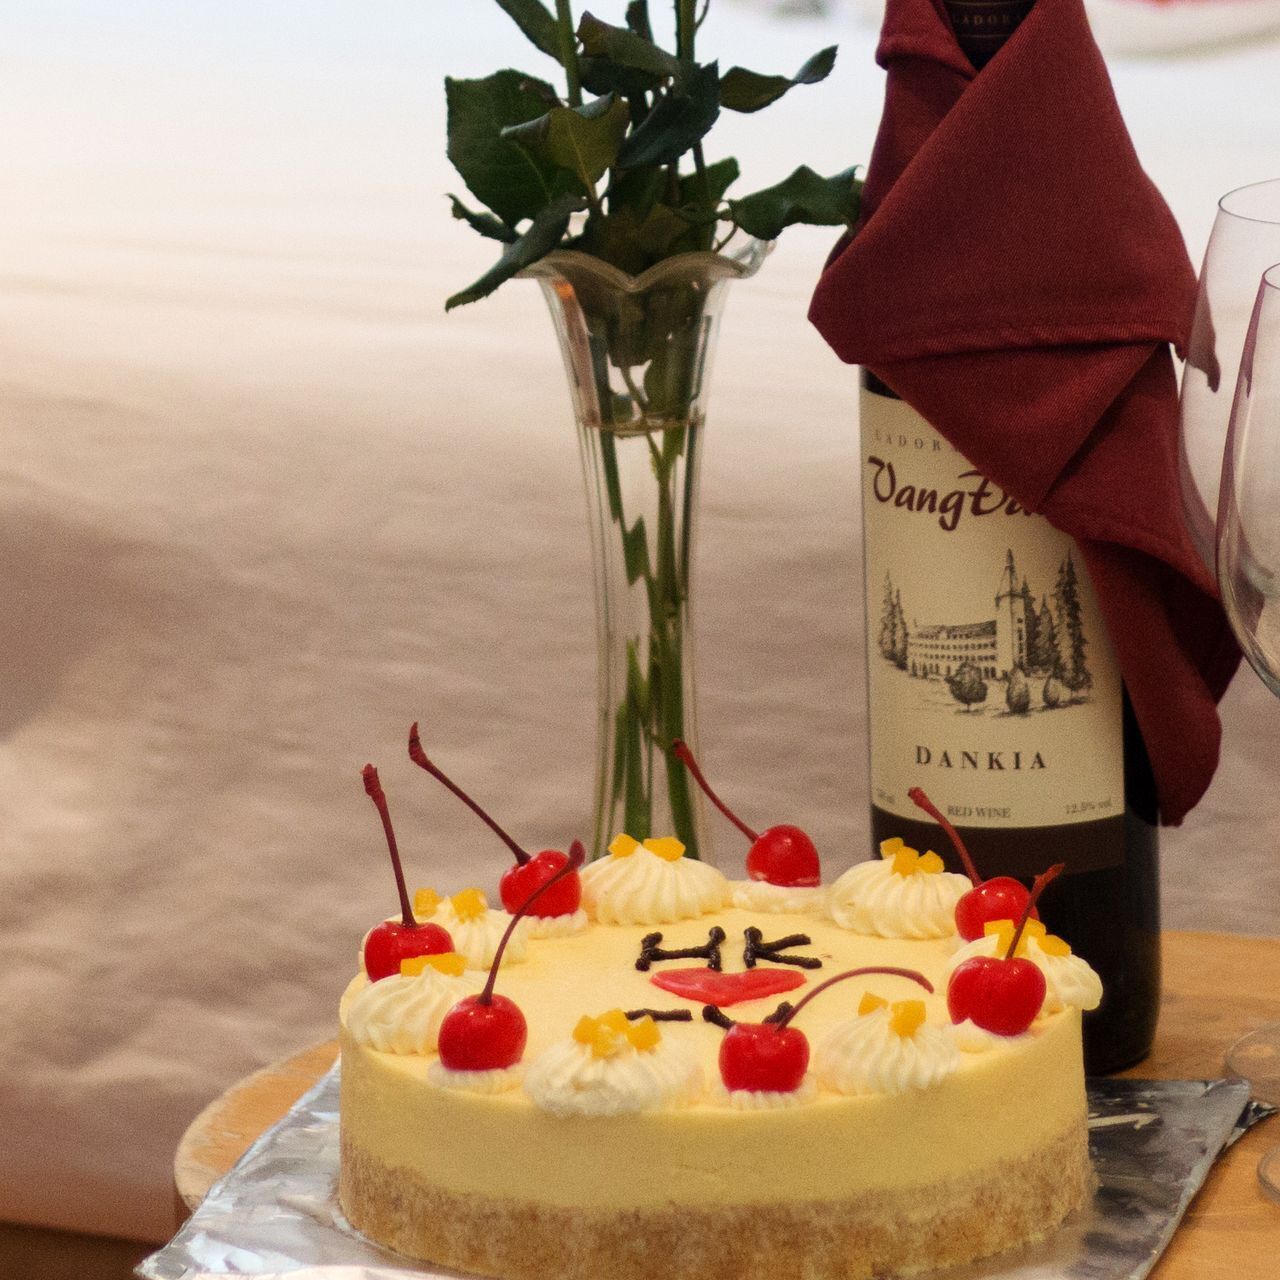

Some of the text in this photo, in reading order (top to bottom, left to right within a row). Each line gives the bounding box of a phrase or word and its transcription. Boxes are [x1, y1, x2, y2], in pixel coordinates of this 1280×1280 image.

[873, 429, 959, 453] LADOR
[915, 745, 1048, 770] DANKIA
[947, 805, 1011, 819] RED WINE
